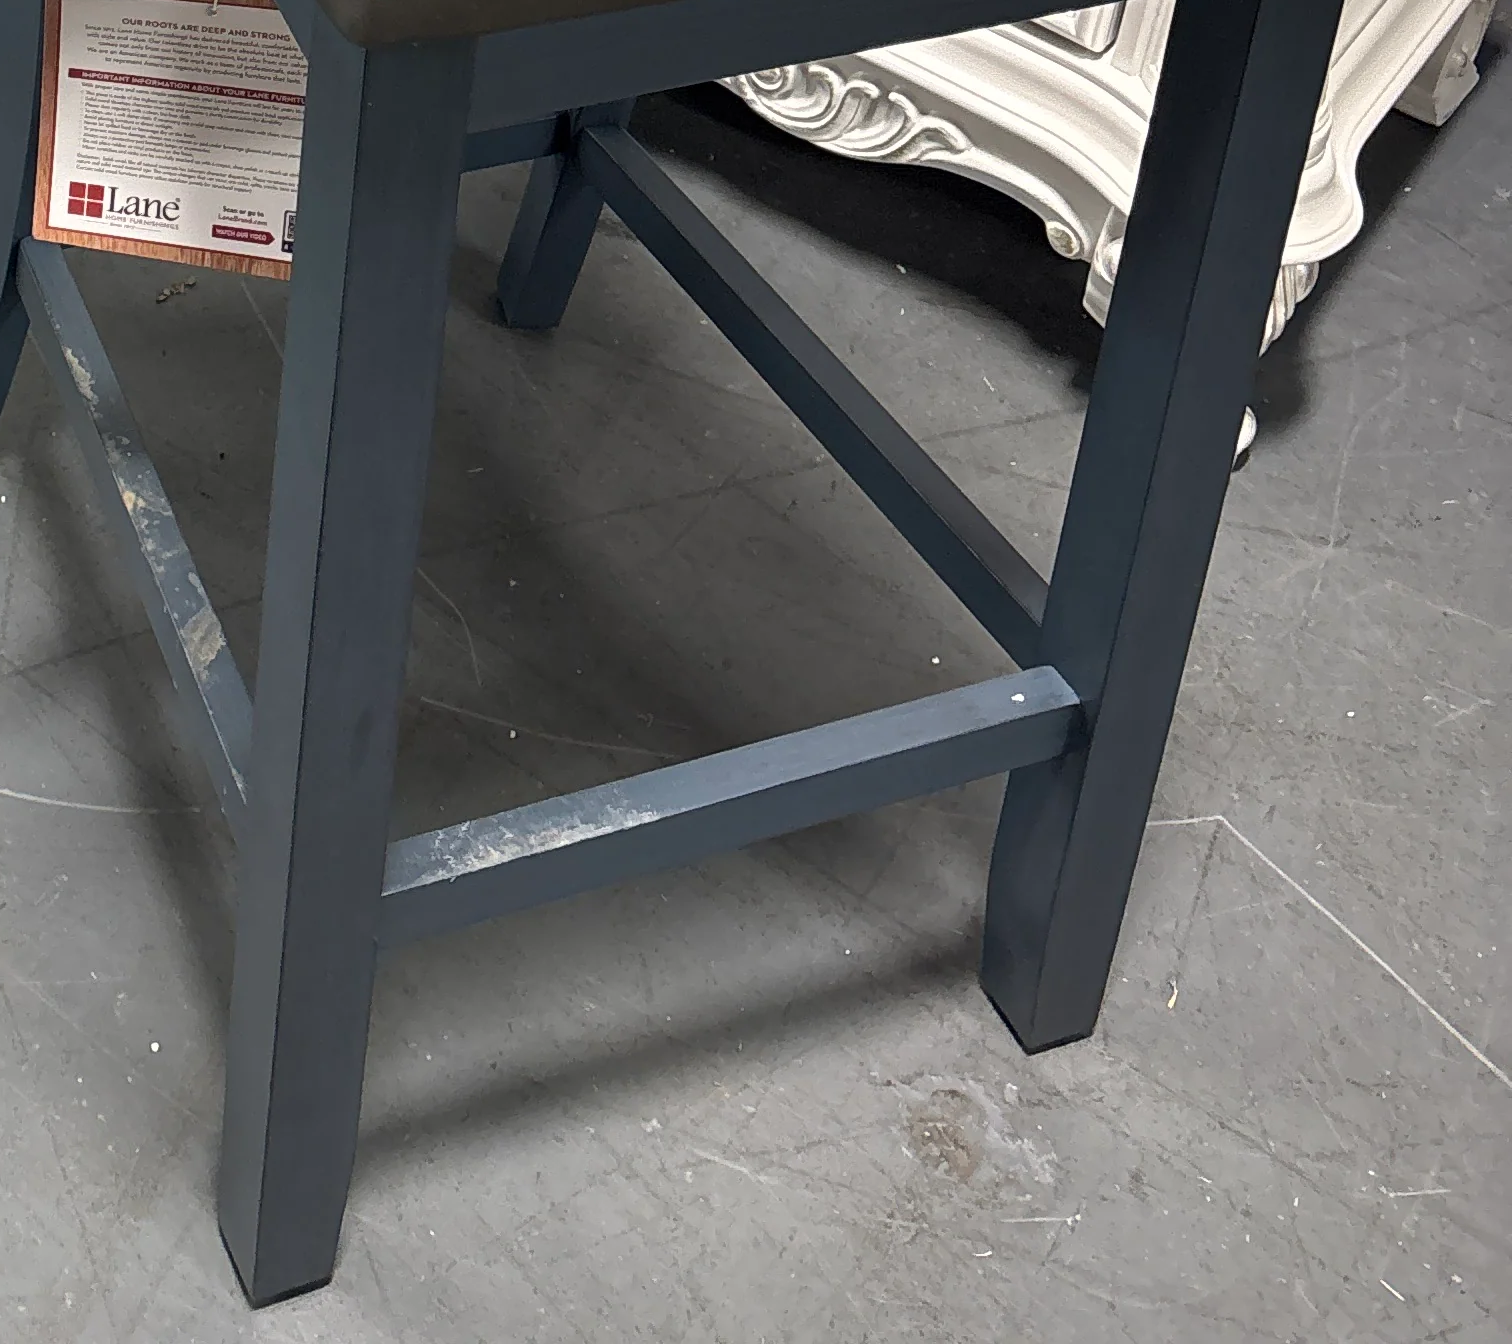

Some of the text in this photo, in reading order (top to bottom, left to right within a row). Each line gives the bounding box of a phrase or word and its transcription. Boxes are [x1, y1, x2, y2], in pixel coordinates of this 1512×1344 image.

[122, 18, 290, 42] OUR ROOTS ARE DEEP AND STRONG
[82, 72, 130, 83] IMPORTANT
[131, 78, 190, 89] INFORMATION
[192, 85, 221, 93] ABOUT
[222, 88, 245, 97] YOUR
[247, 91, 270, 100] LANE
[106, 186, 180, 221] Lane
